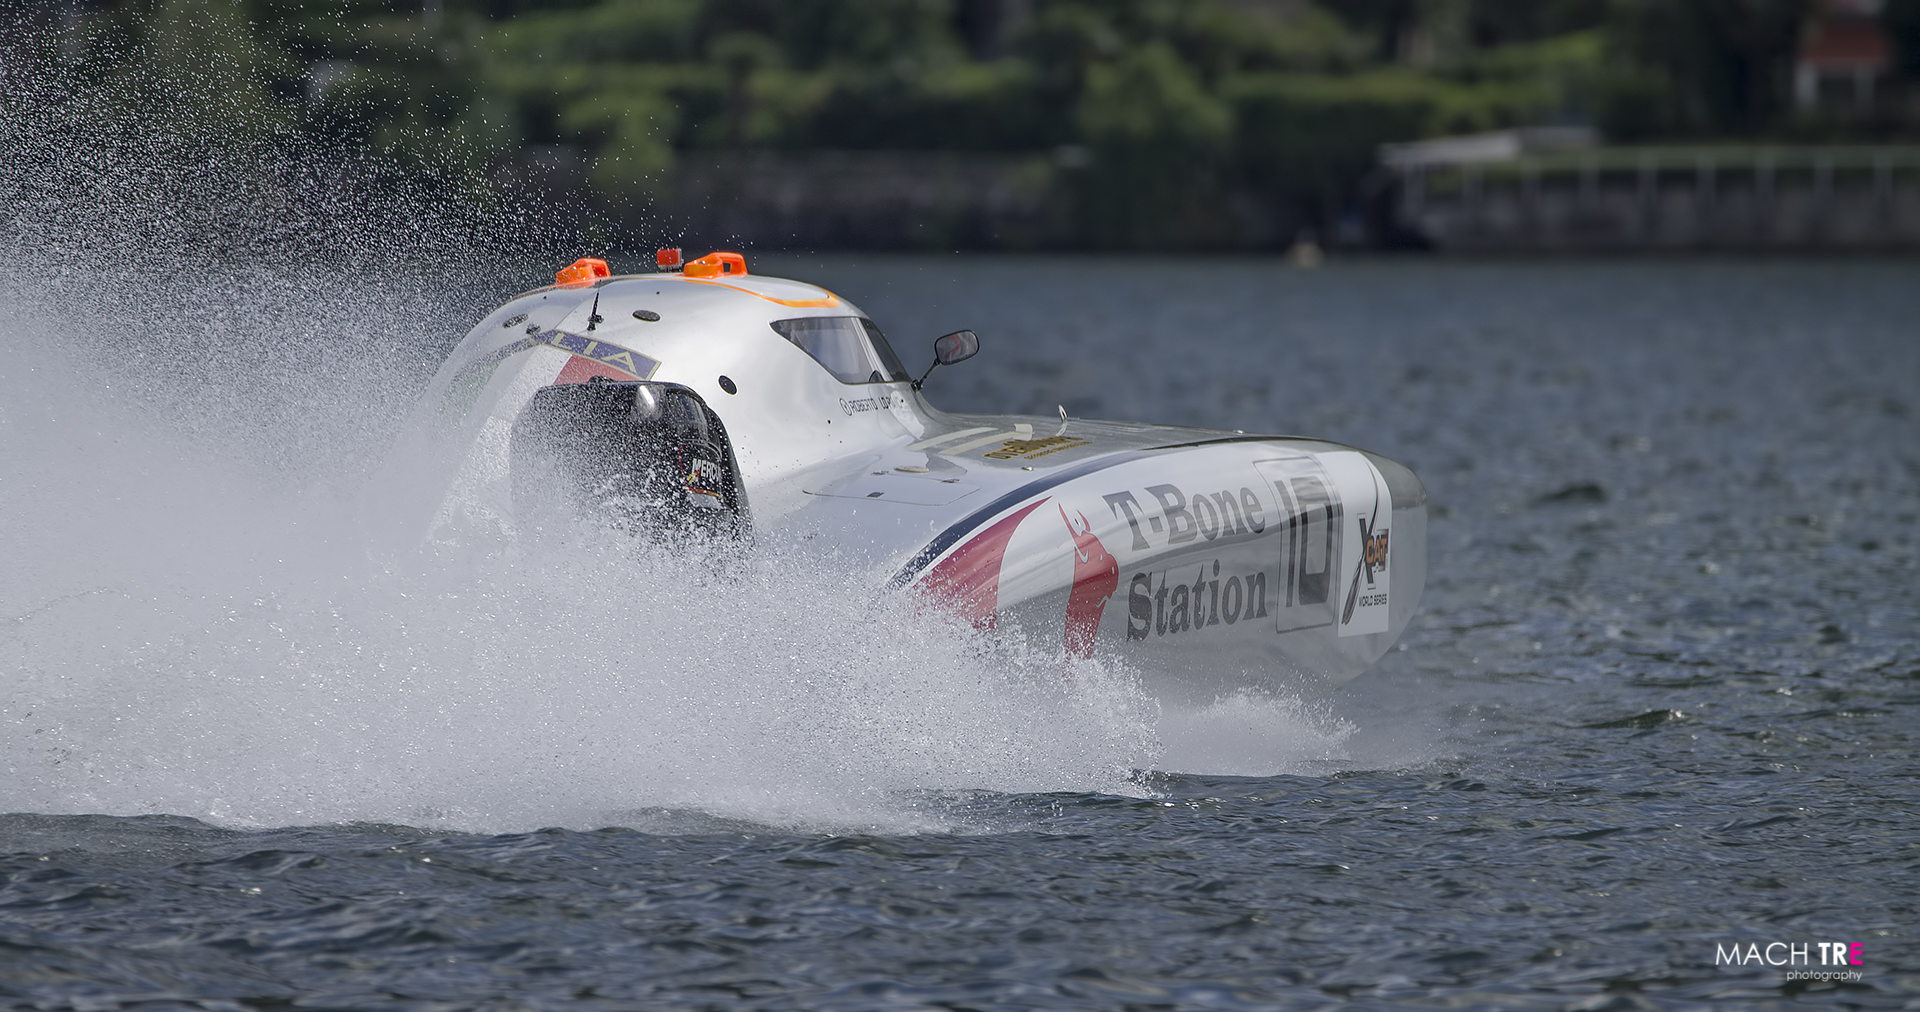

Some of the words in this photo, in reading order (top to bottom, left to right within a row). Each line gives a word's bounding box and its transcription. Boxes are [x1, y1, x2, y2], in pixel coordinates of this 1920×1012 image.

[1102, 484, 1266, 551] T-Bone
[1274, 476, 1334, 608] 10
[1126, 559, 1268, 642] Station
[1358, 595, 1373, 607] WORLD
[1373, 593, 1387, 606] SERIES
